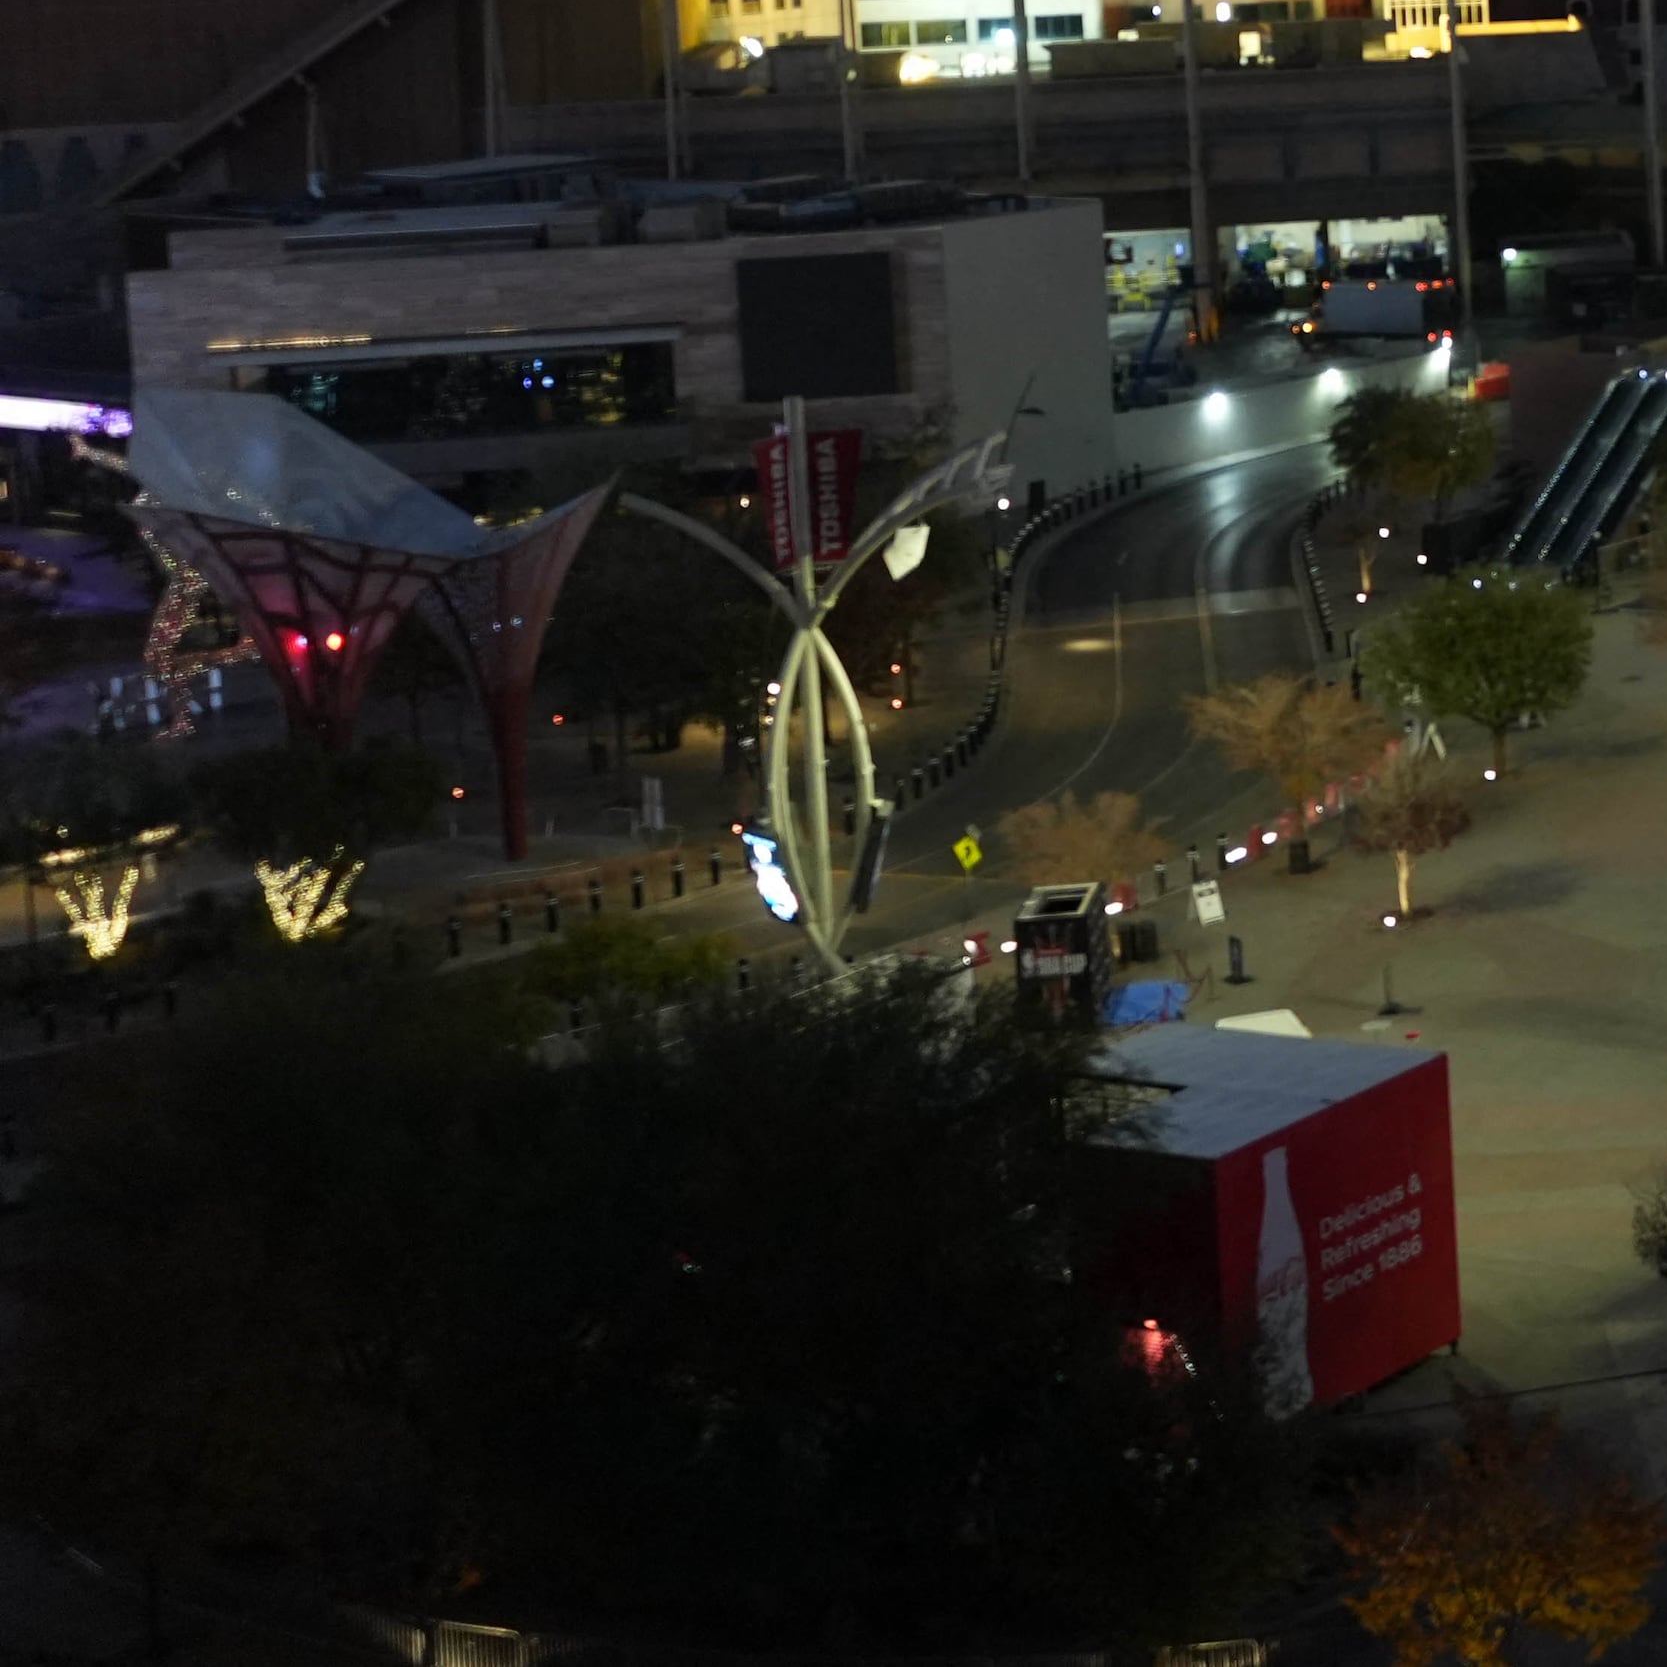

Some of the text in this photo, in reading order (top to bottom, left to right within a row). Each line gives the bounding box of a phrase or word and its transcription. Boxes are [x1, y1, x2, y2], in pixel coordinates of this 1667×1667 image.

[769, 443, 793, 564] TOSHIBA
[813, 437, 844, 556] TOSHIBA
[1319, 1172, 1423, 1240] Delicious &
[1320, 1207, 1422, 1270] Refreshing
[1322, 1233, 1423, 1303] Since 1886
